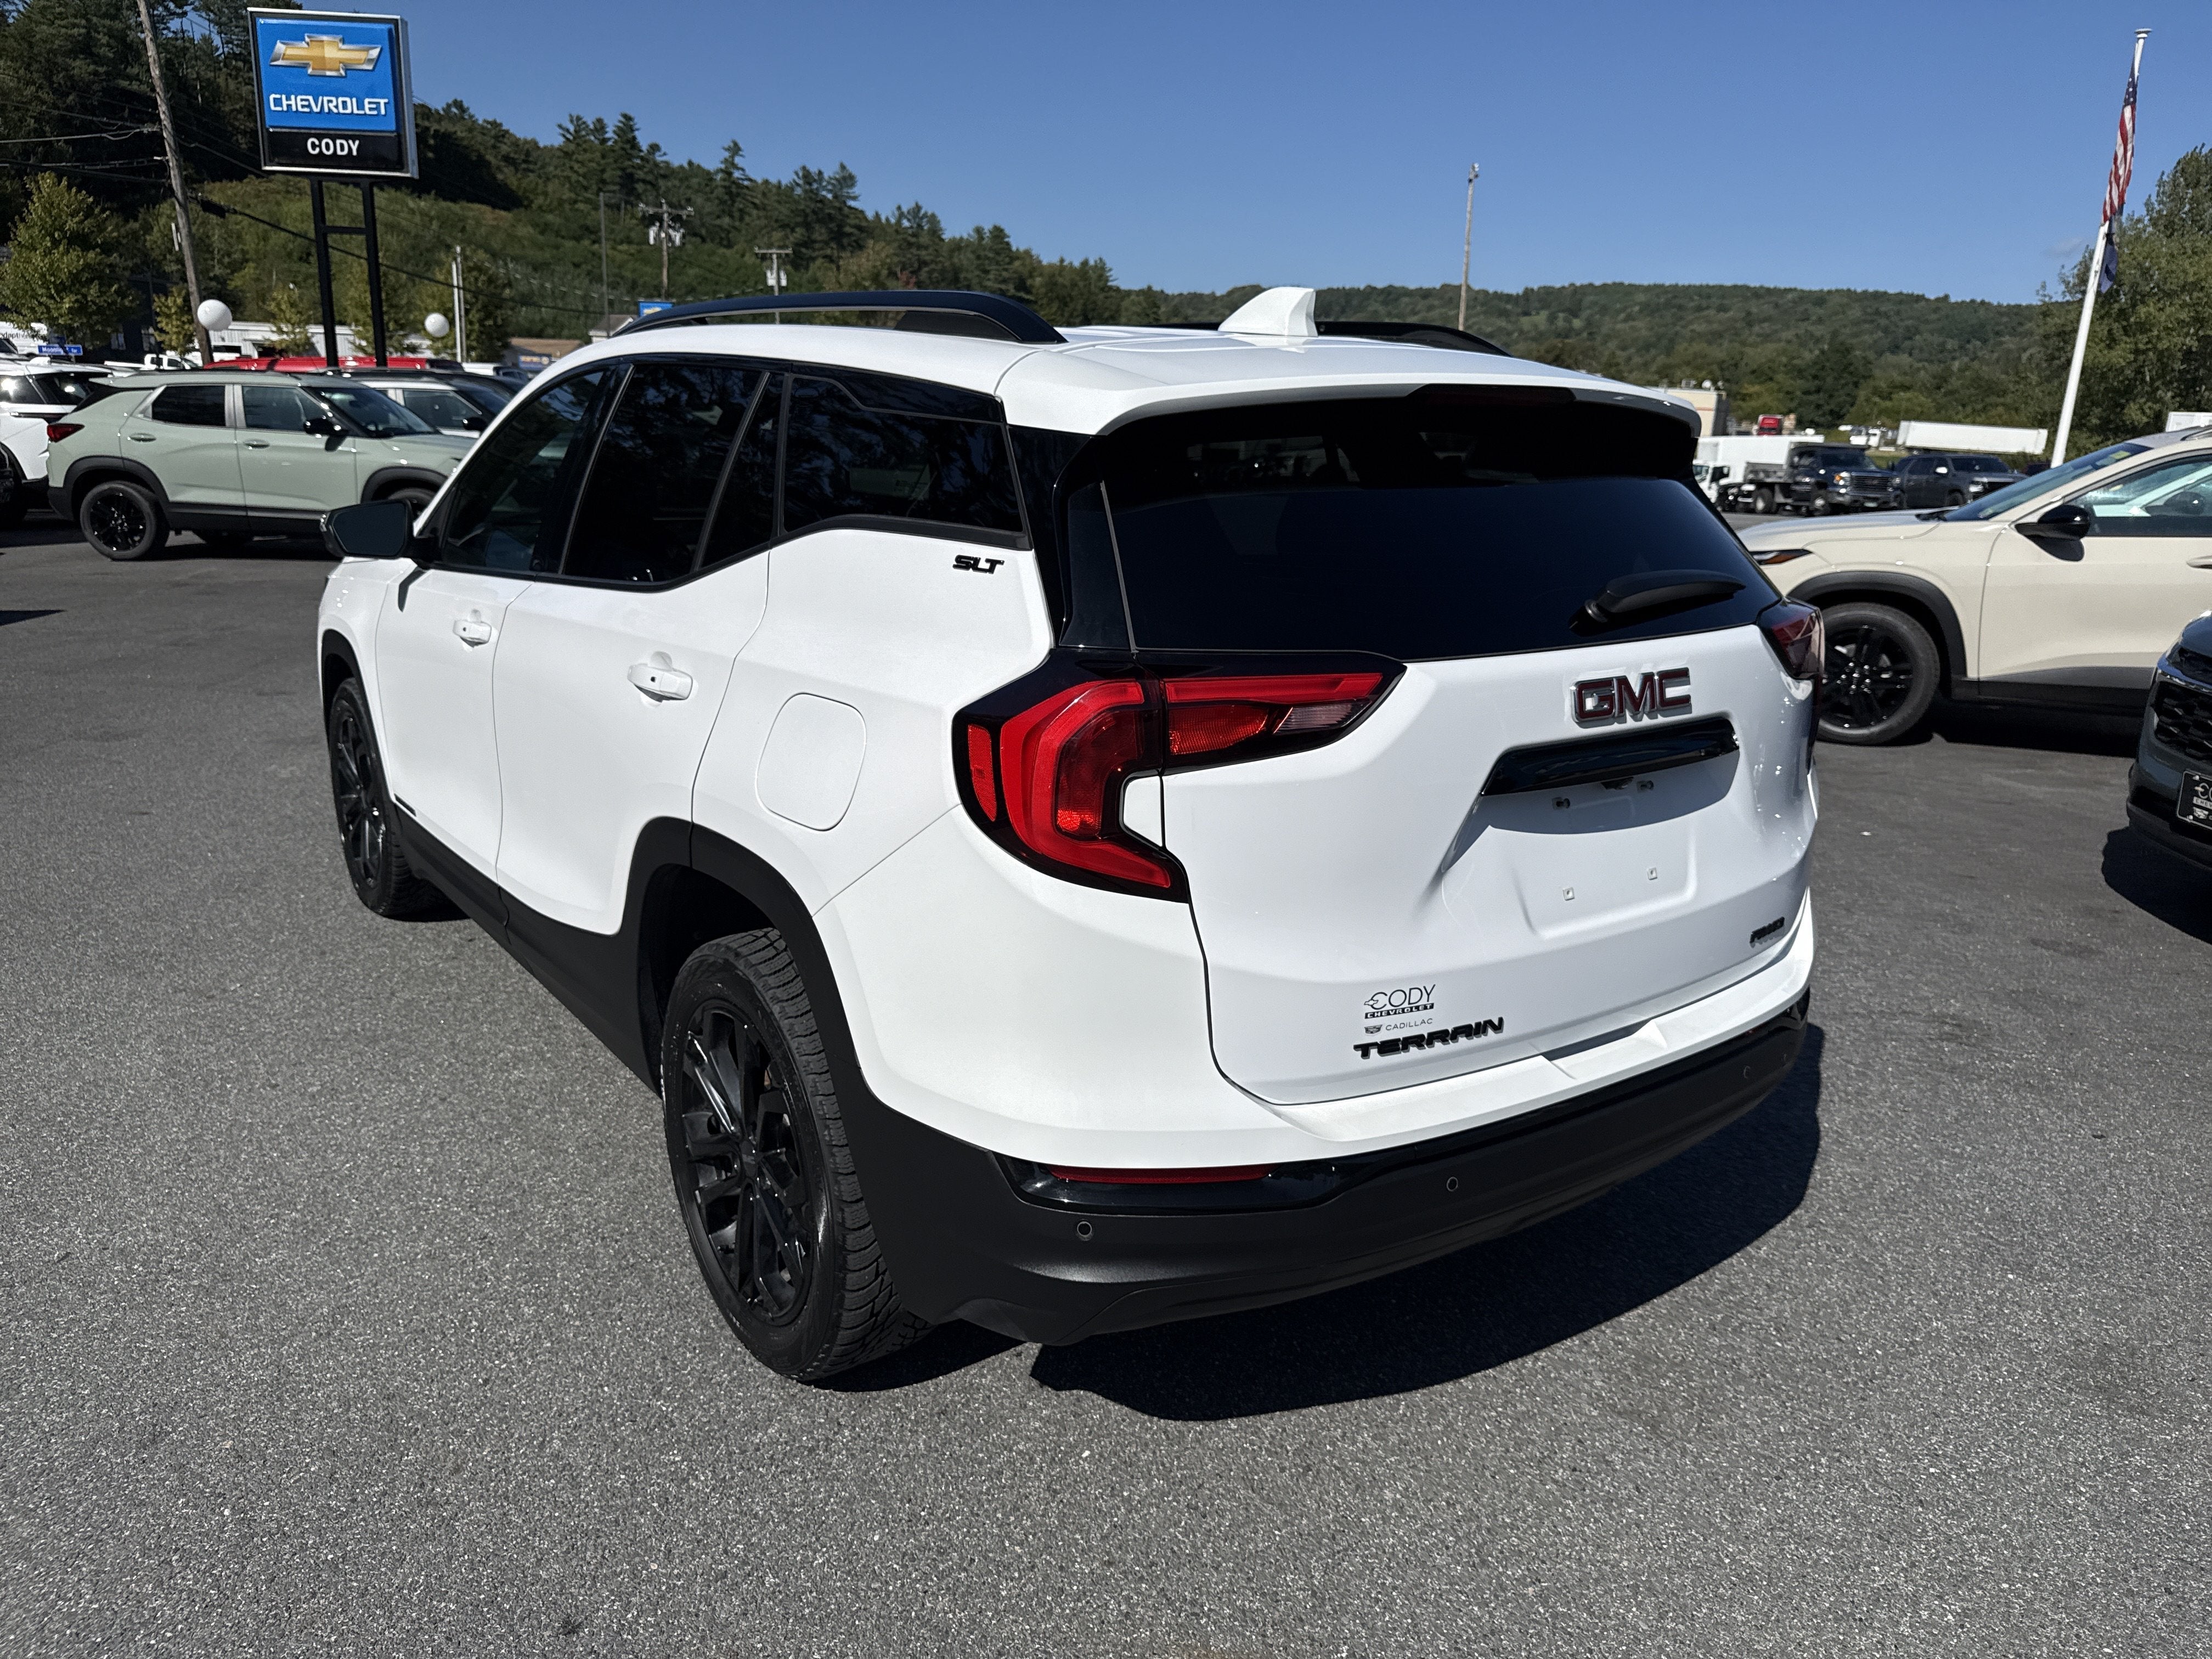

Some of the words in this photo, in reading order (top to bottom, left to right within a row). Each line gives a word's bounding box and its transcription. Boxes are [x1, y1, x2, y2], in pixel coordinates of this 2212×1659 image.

[269, 94, 388, 115] CHEVROLET
[307, 138, 359, 156] CODY
[952, 555, 1005, 574] SLT
[1571, 667, 1692, 723] GMC
[1371, 984, 1436, 1010] CODY
[1366, 1003, 1434, 1018] CHEVROLET
[1385, 1018, 1433, 1031] CADILLAC
[1353, 1017, 1504, 1059] TERRAIN
